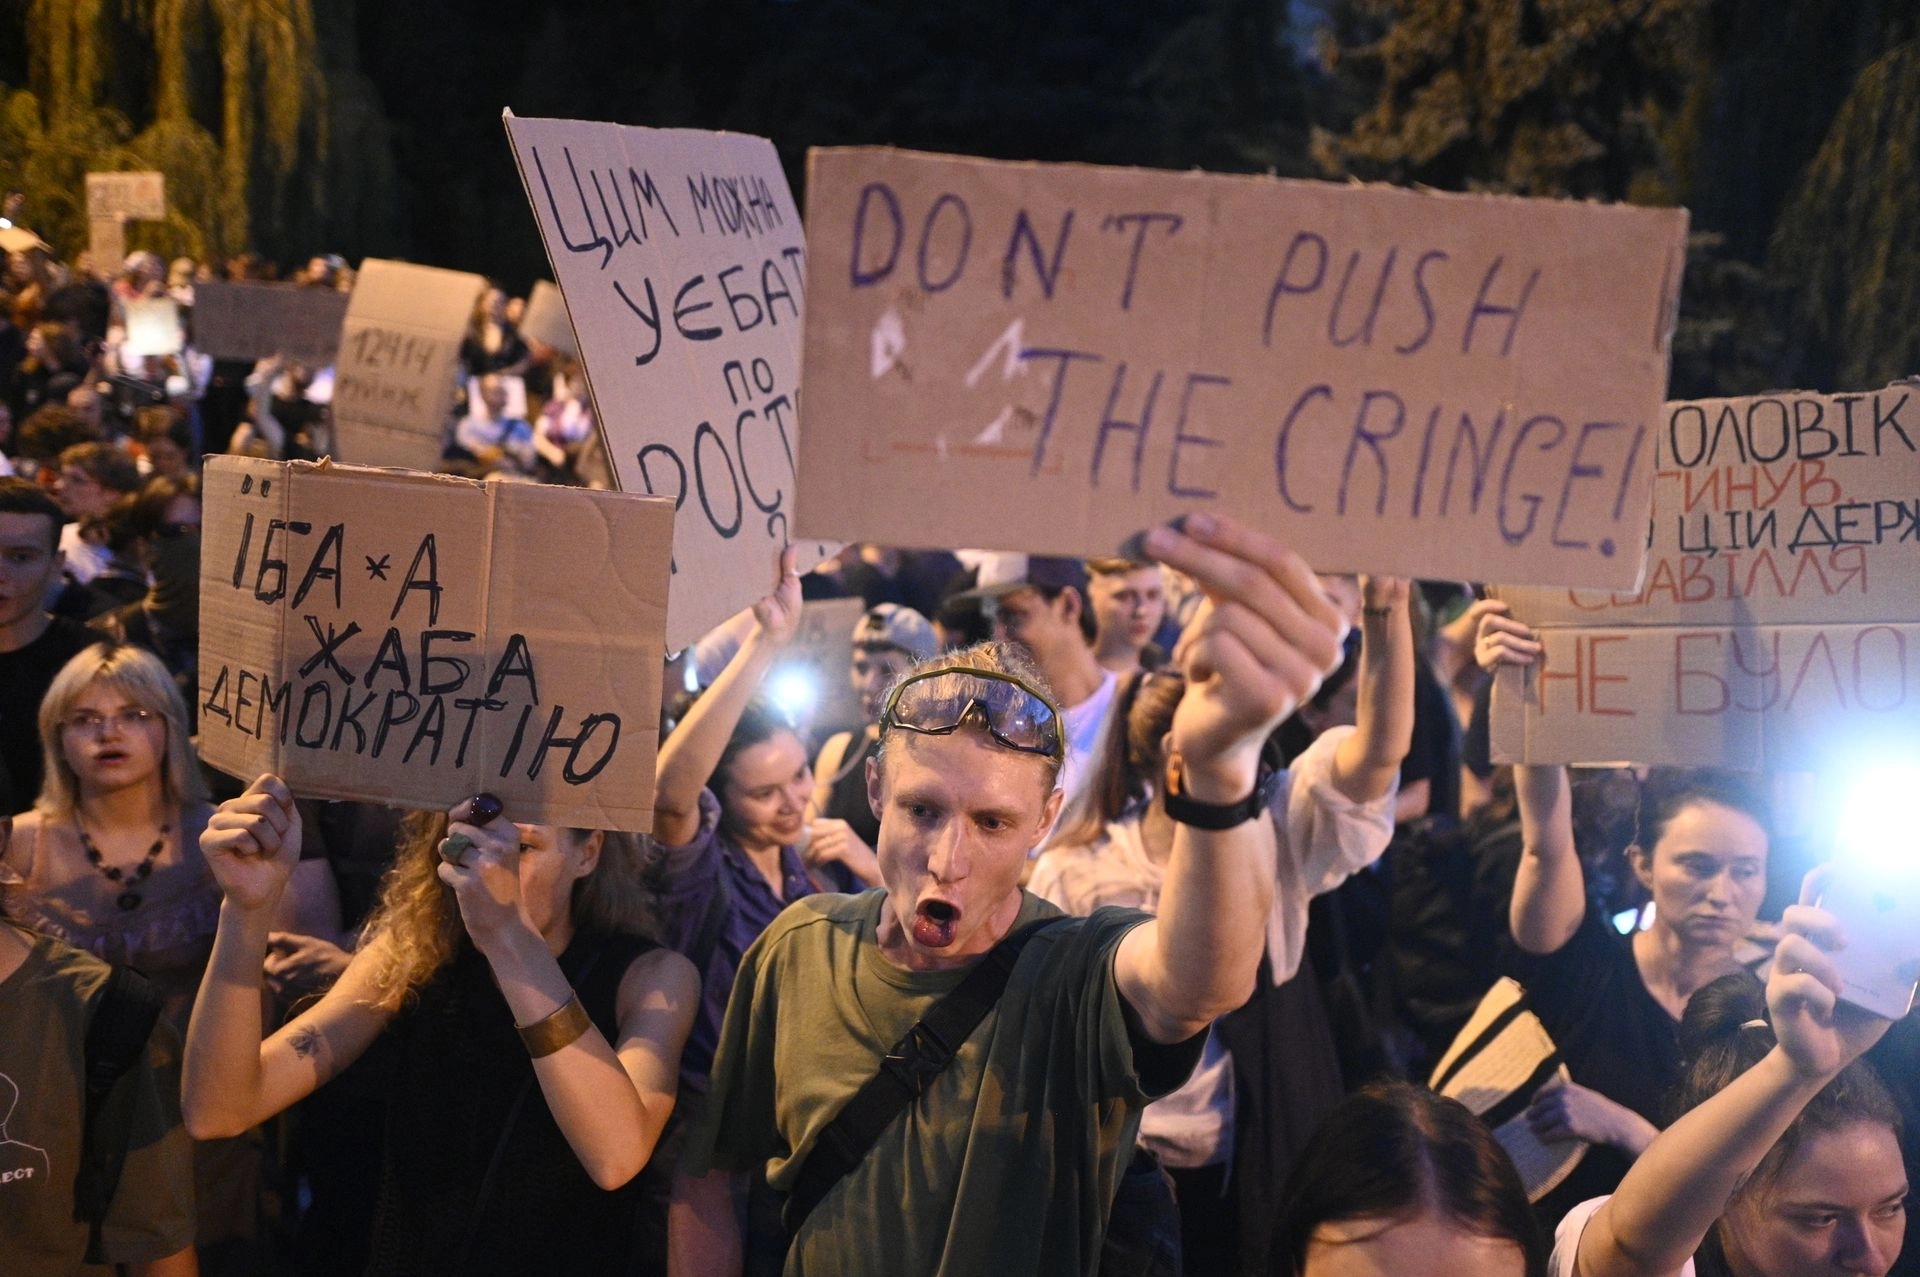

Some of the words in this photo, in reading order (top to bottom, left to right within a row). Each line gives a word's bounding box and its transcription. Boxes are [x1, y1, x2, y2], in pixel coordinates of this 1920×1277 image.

[533, 146, 680, 270] ЦИМ
[613, 246, 806, 366] УЄБАТ
[849, 182, 1183, 312] DON'T
[1263, 232, 1540, 358] PUSH
[723, 357, 774, 405] ПО
[1016, 347, 1233, 503] THE
[1276, 384, 1646, 557] CRINGE!
[1655, 393, 1916, 475] ОЛОВІК
[298, 615, 540, 706] ЖАБА
[1538, 633, 1636, 717] НЕ
[1675, 626, 1907, 717] БУЛО
[203, 664, 622, 786] ДЕМОКРАТІЮ
[0, 1167, 35, 1184] ECT
